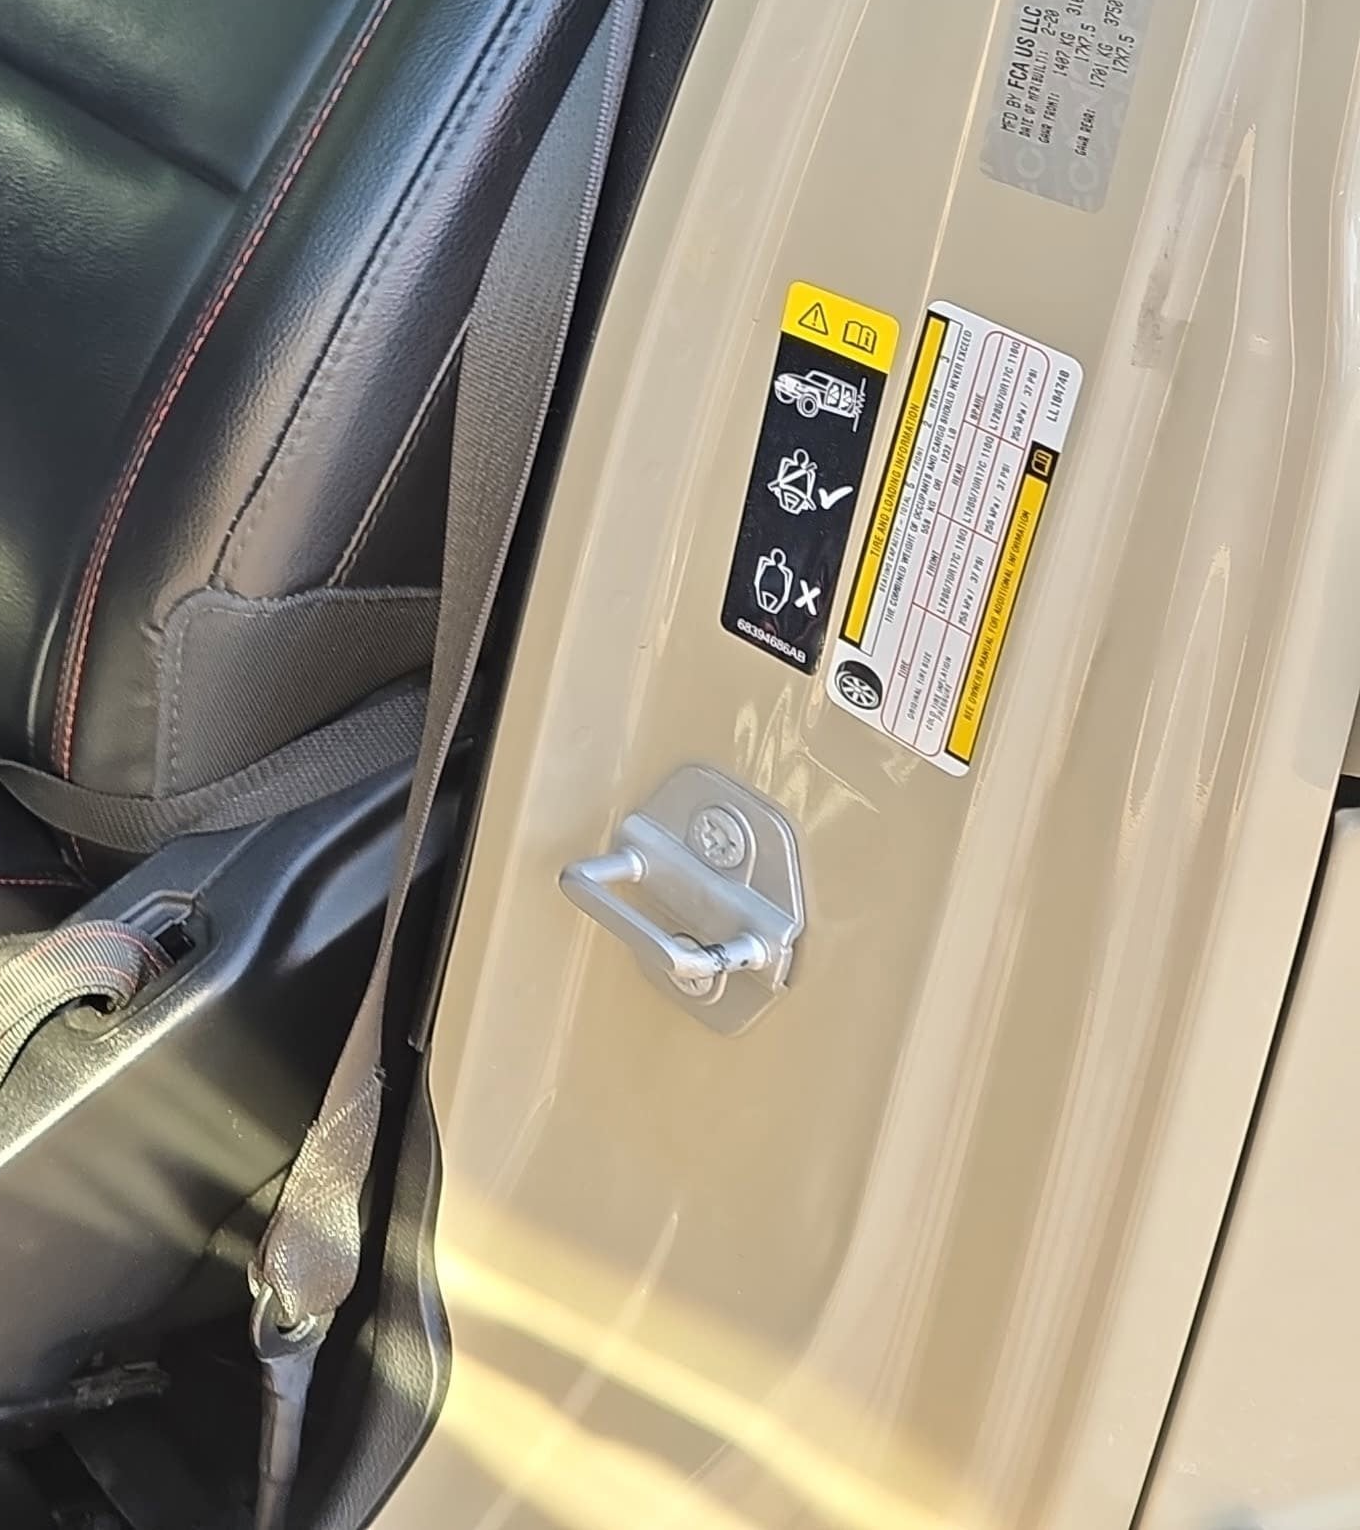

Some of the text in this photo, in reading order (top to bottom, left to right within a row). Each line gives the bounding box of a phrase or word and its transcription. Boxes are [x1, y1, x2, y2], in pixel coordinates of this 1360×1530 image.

[1040, 8, 1059, 36] 2-20
[1102, 0, 1123, 27] 3750
[1059, 31, 1076, 47] KG
[1073, 22, 1096, 62] 17X7.5
[1096, 42, 1114, 58] KG
[1052, 49, 1070, 76] 1407
[1111, 33, 1135, 74] 17X7.5
[1000, 5, 1042, 132] MFD BY FCA US LLC
[1089, 62, 1109, 88] 1701
[1023, 103, 1035, 114] OF
[1018, 117, 1034, 138] DATE
[921, 419, 932, 428] 2
[869, 402, 919, 557] TIRE AND LOADING INFORMATION
